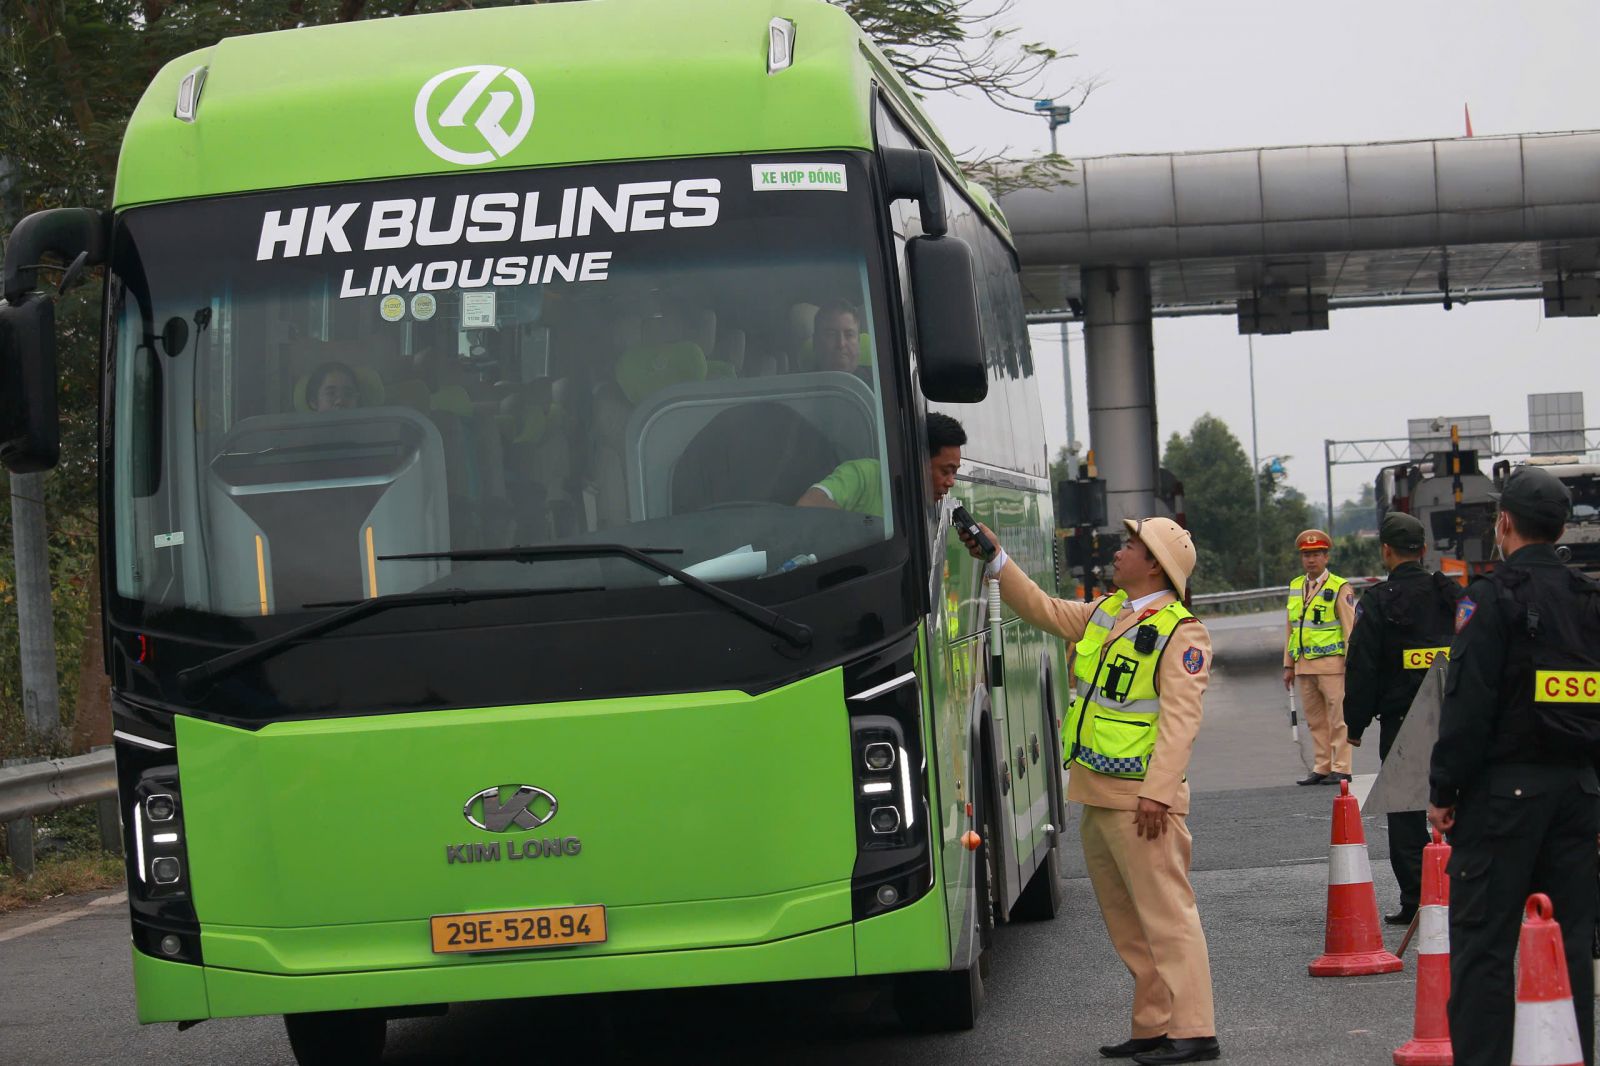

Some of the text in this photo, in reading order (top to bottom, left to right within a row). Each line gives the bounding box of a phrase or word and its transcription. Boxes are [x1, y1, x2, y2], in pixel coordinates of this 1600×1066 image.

[761, 170, 778, 185] XE
[780, 169, 805, 187] HỢP
[256, 178, 722, 261] HK BUSLINES
[339, 251, 613, 299] LIMOUSINE
[446, 836, 582, 864] KIM LONG
[446, 913, 591, 946] 29E-528.94
